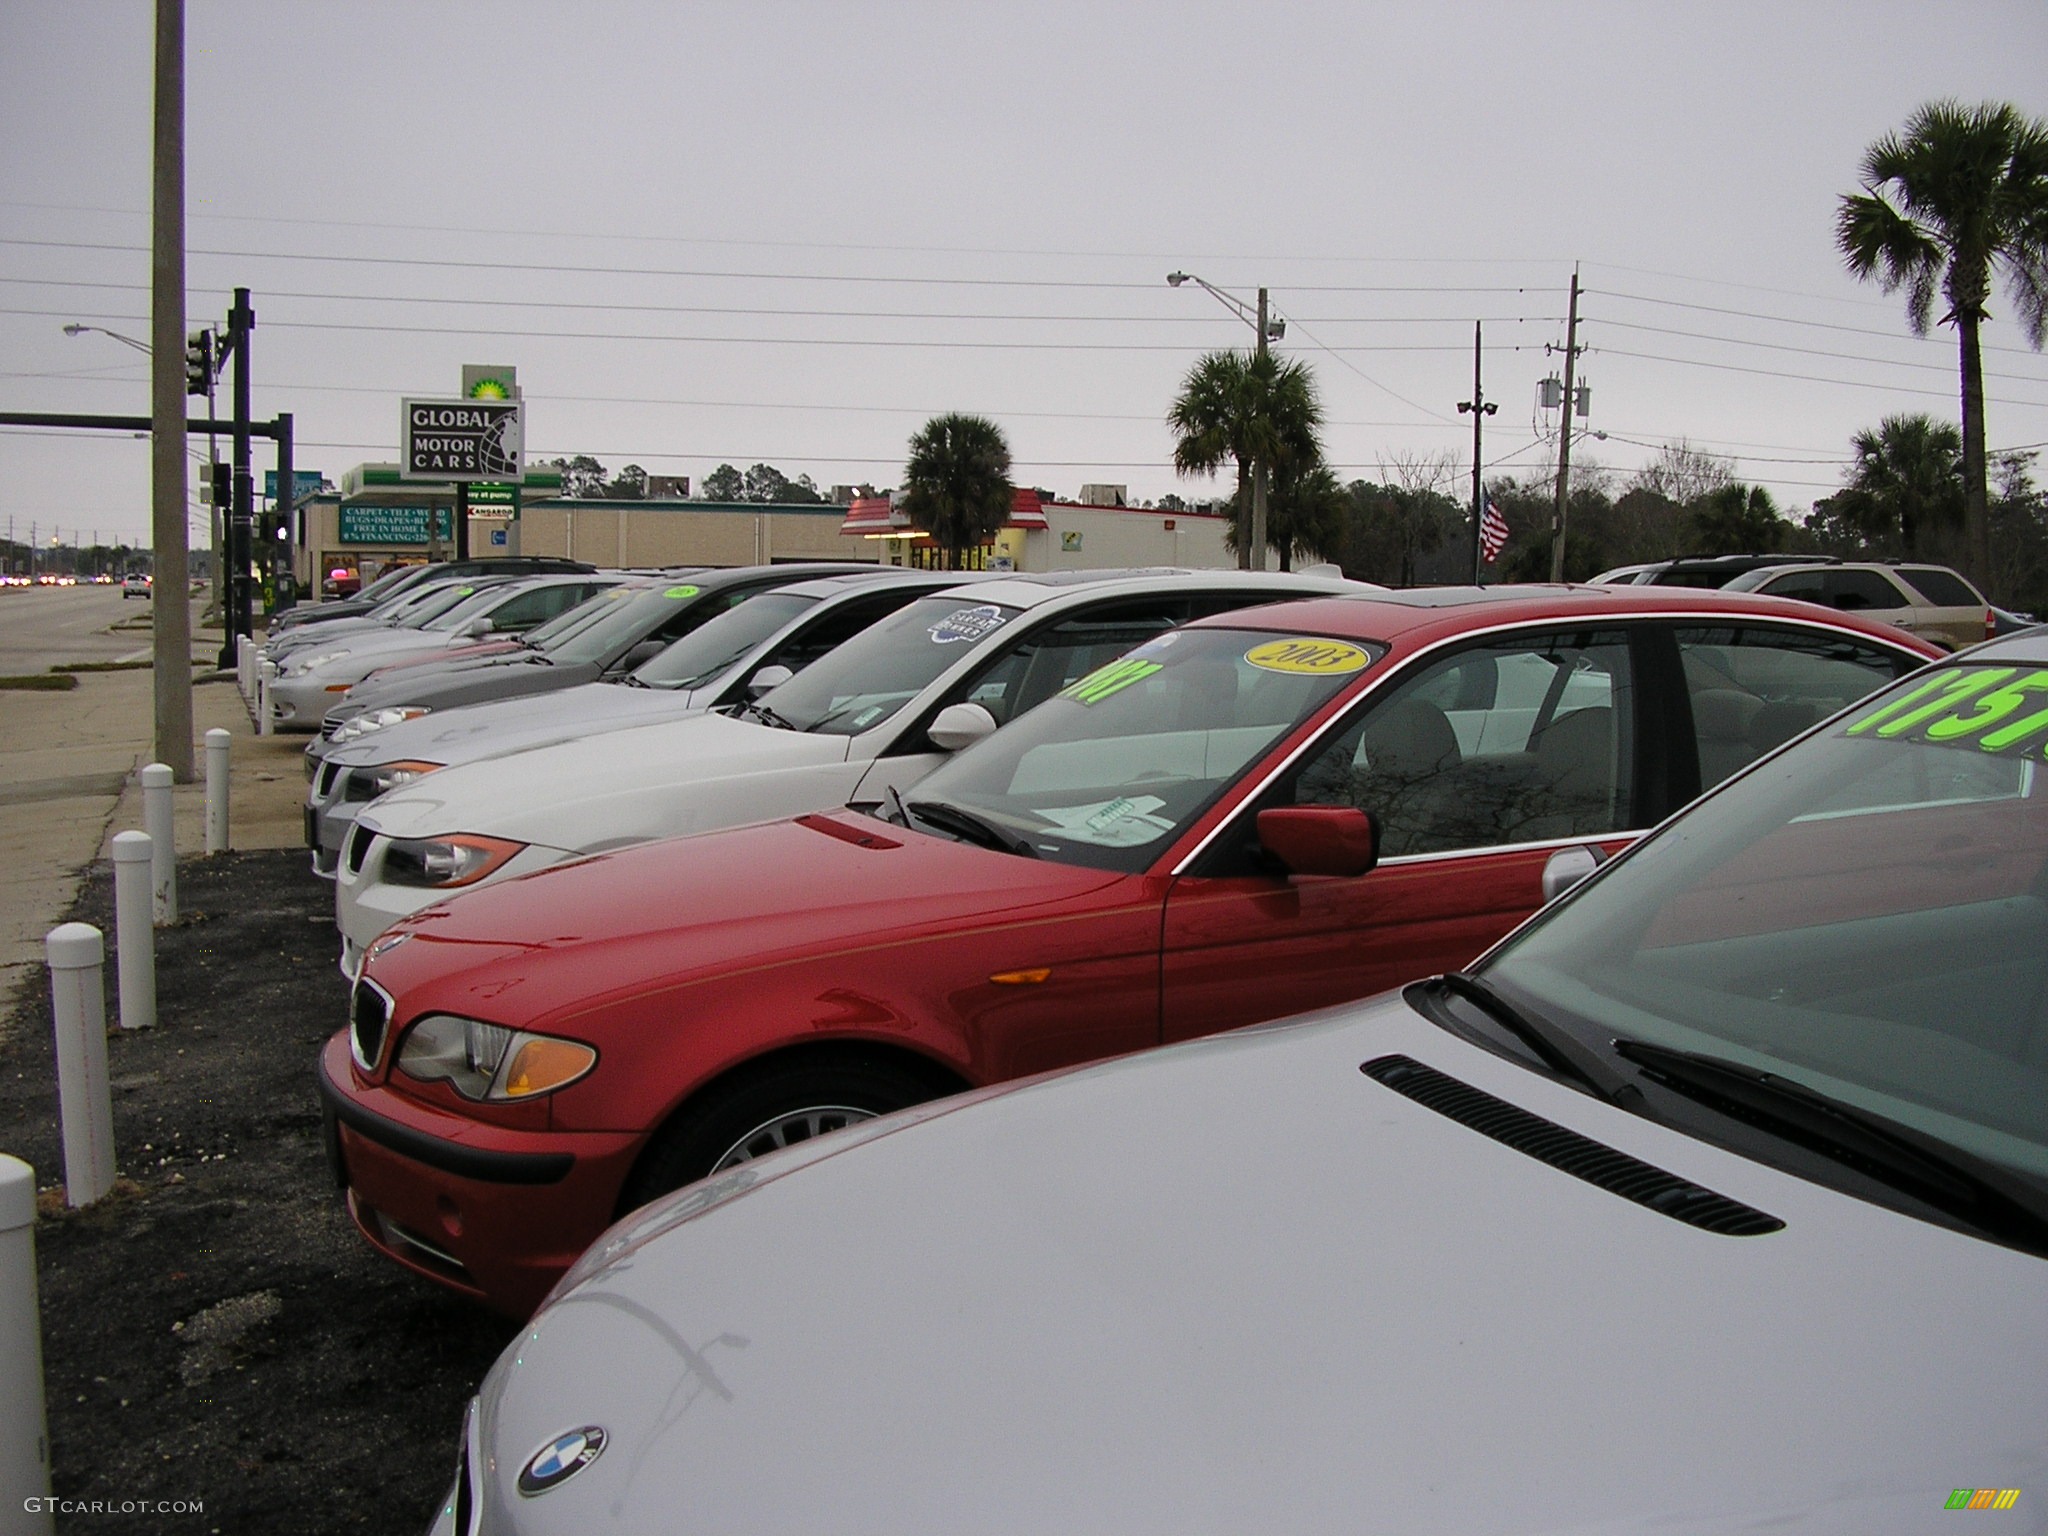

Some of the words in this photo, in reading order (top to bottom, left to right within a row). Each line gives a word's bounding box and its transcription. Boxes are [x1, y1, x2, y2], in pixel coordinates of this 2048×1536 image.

[412, 409, 492, 427] GLOBAL
[415, 438, 475, 452] MOTOR
[414, 453, 475, 468] CARS
[346, 508, 382, 516] CARPET
[390, 508, 411, 516] TILE
[417, 508, 445, 517] WOD
[353, 524, 375, 532] FREE
[391, 525, 416, 533] HOME
[361, 533, 411, 541] FINANCING
[1255, 643, 1356, 667] 2003
